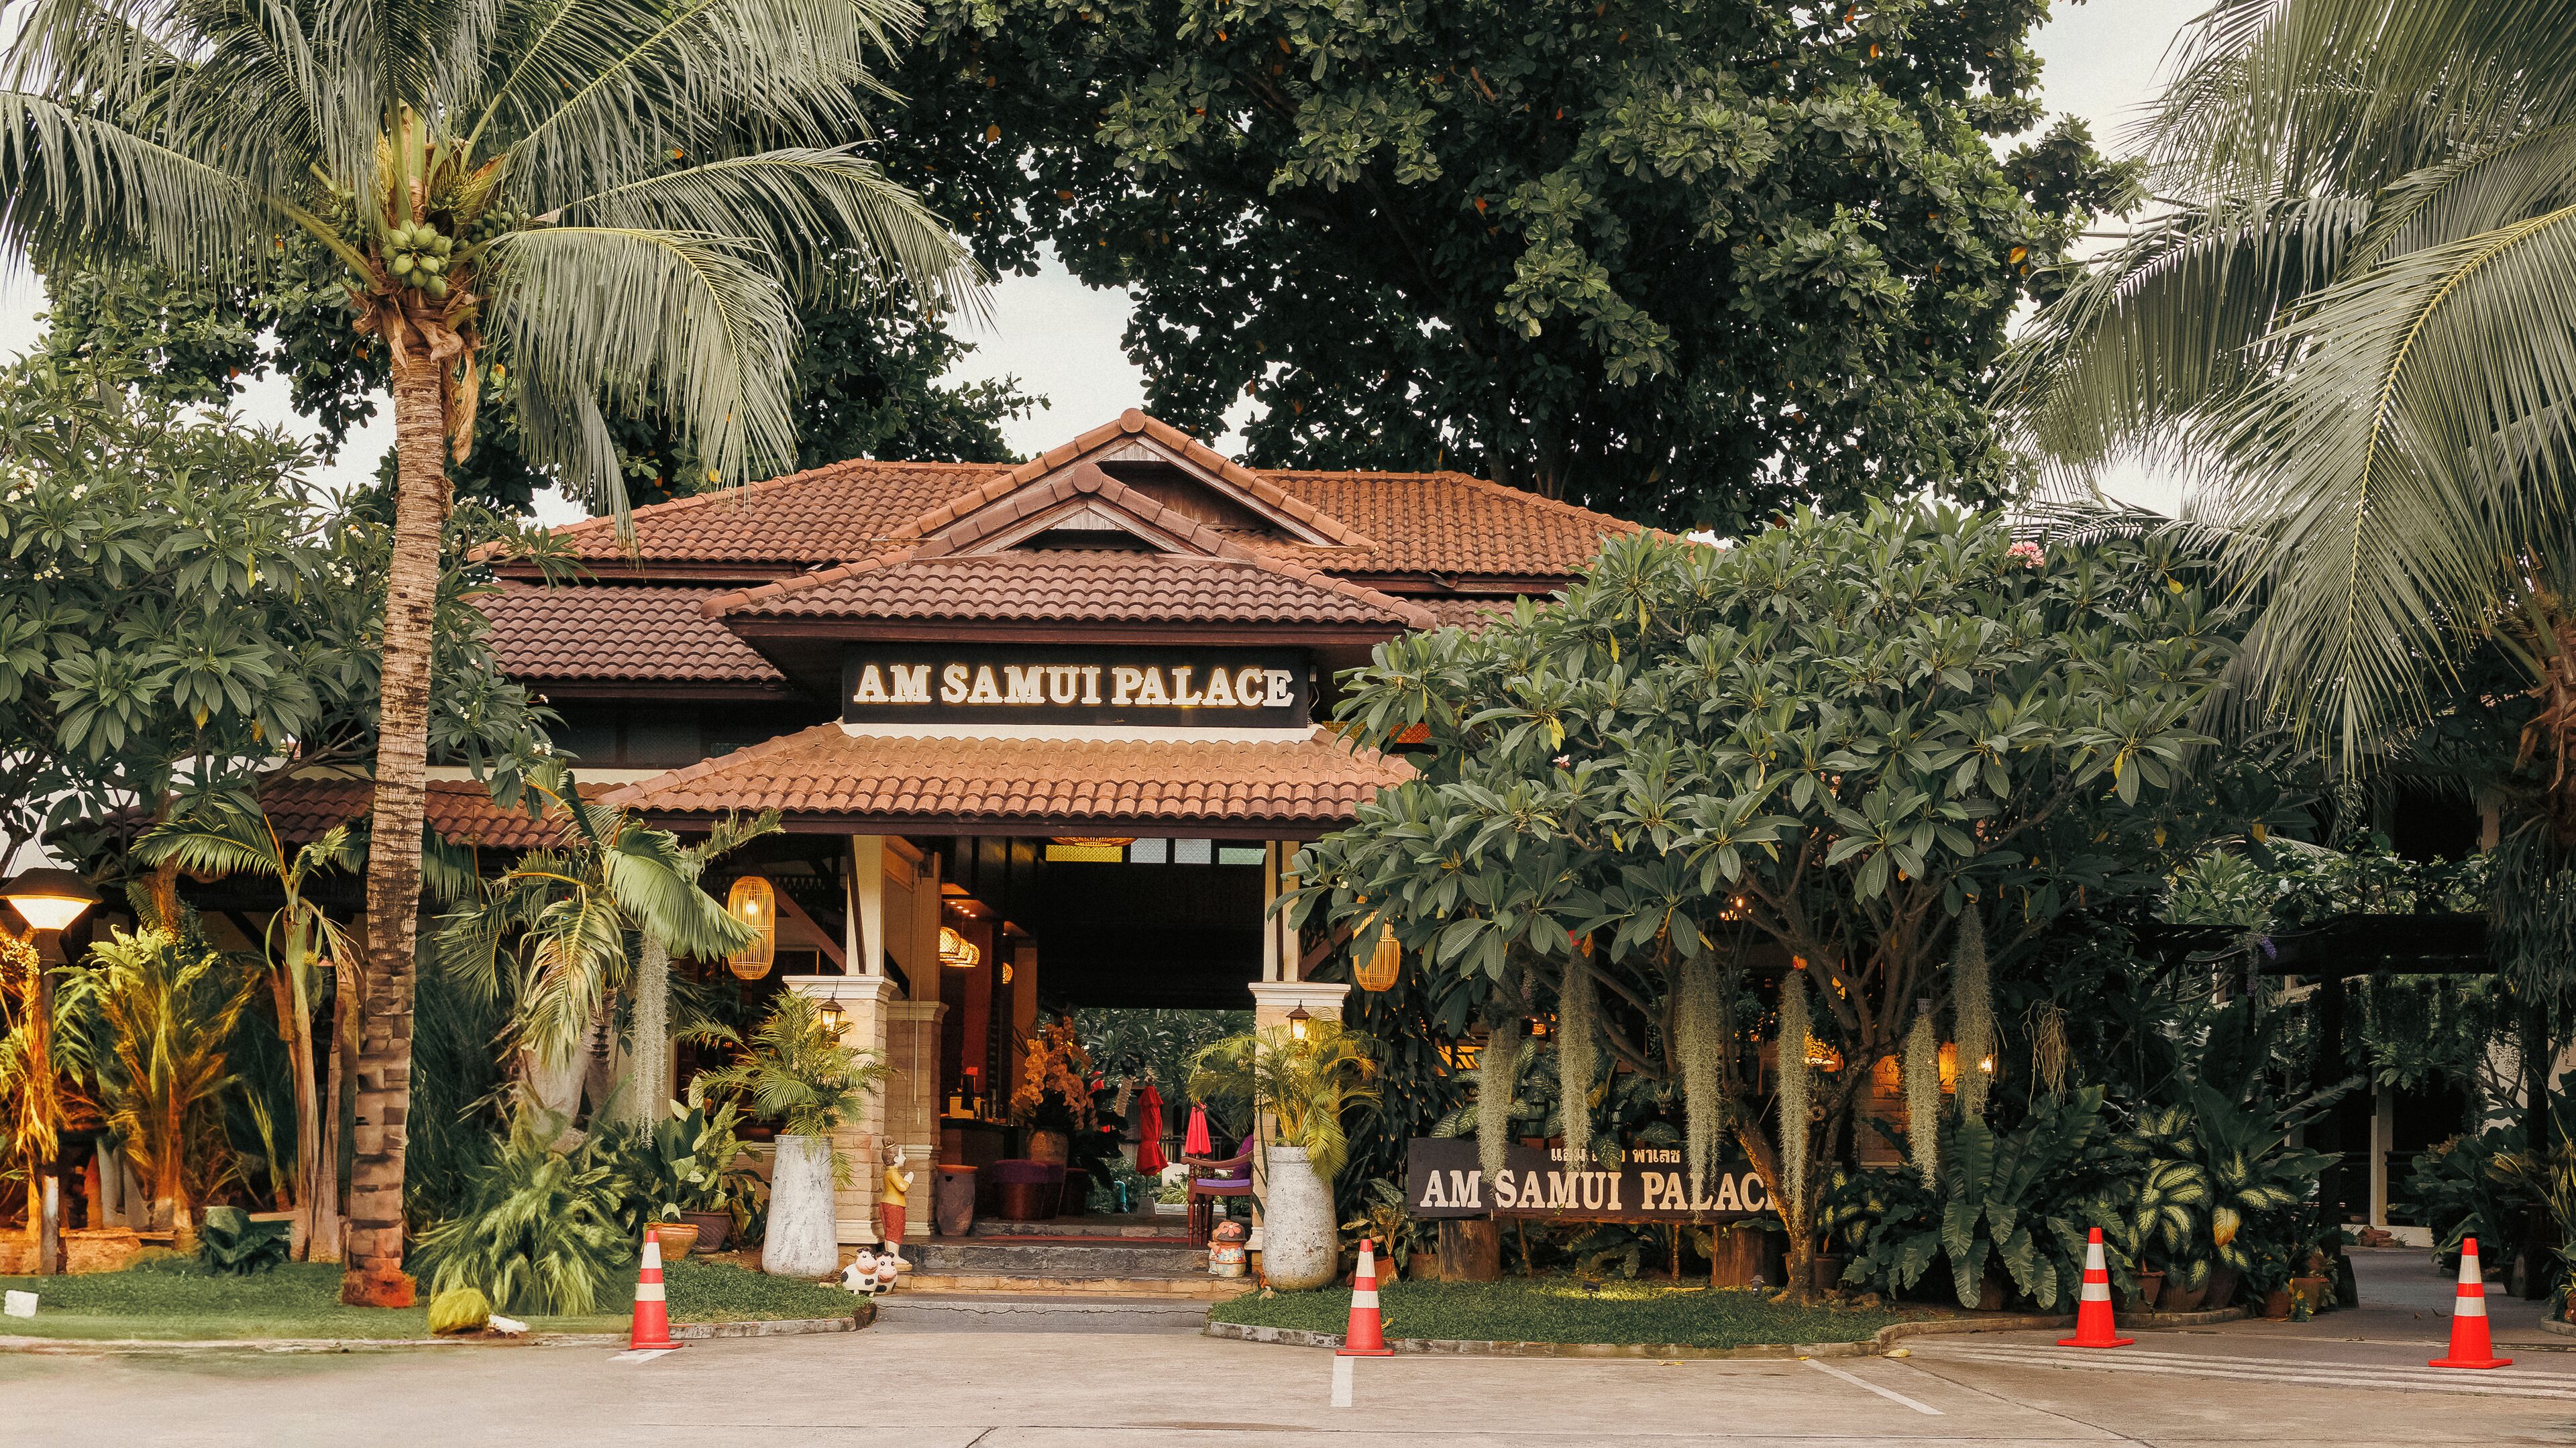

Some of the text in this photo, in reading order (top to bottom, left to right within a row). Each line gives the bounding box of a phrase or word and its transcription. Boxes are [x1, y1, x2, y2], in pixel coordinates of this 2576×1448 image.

[853, 664, 1295, 707] AM SAMUI PALACE
[1419, 1169, 1778, 1212] AM SAMUI PALAC
